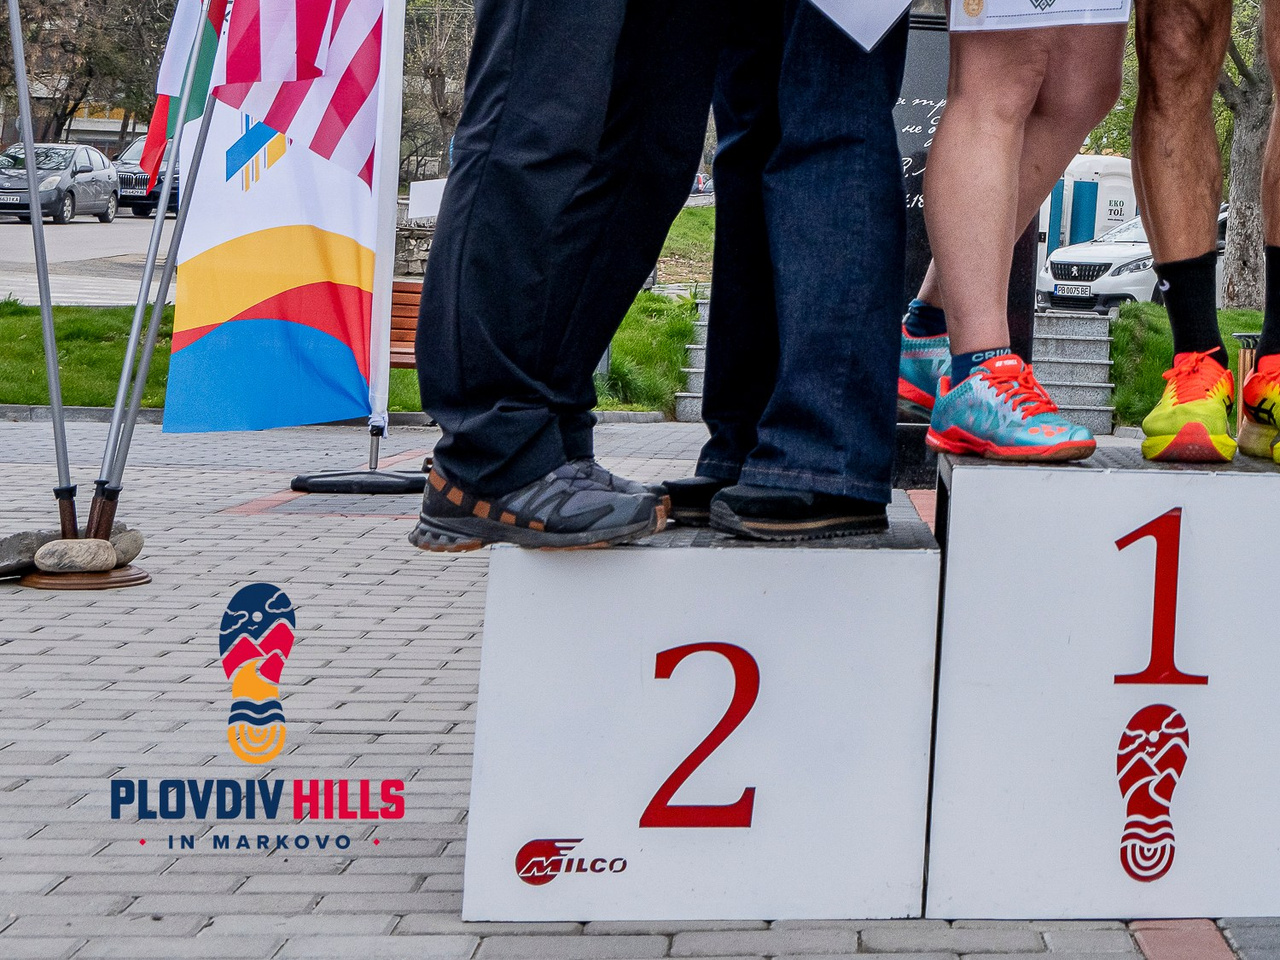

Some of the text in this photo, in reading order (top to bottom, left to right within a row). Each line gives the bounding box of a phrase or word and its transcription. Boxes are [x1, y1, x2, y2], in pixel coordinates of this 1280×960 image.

[1114, 506, 1208, 686] 1
[639, 641, 762, 829] 2
[518, 856, 627, 877] MILCO
